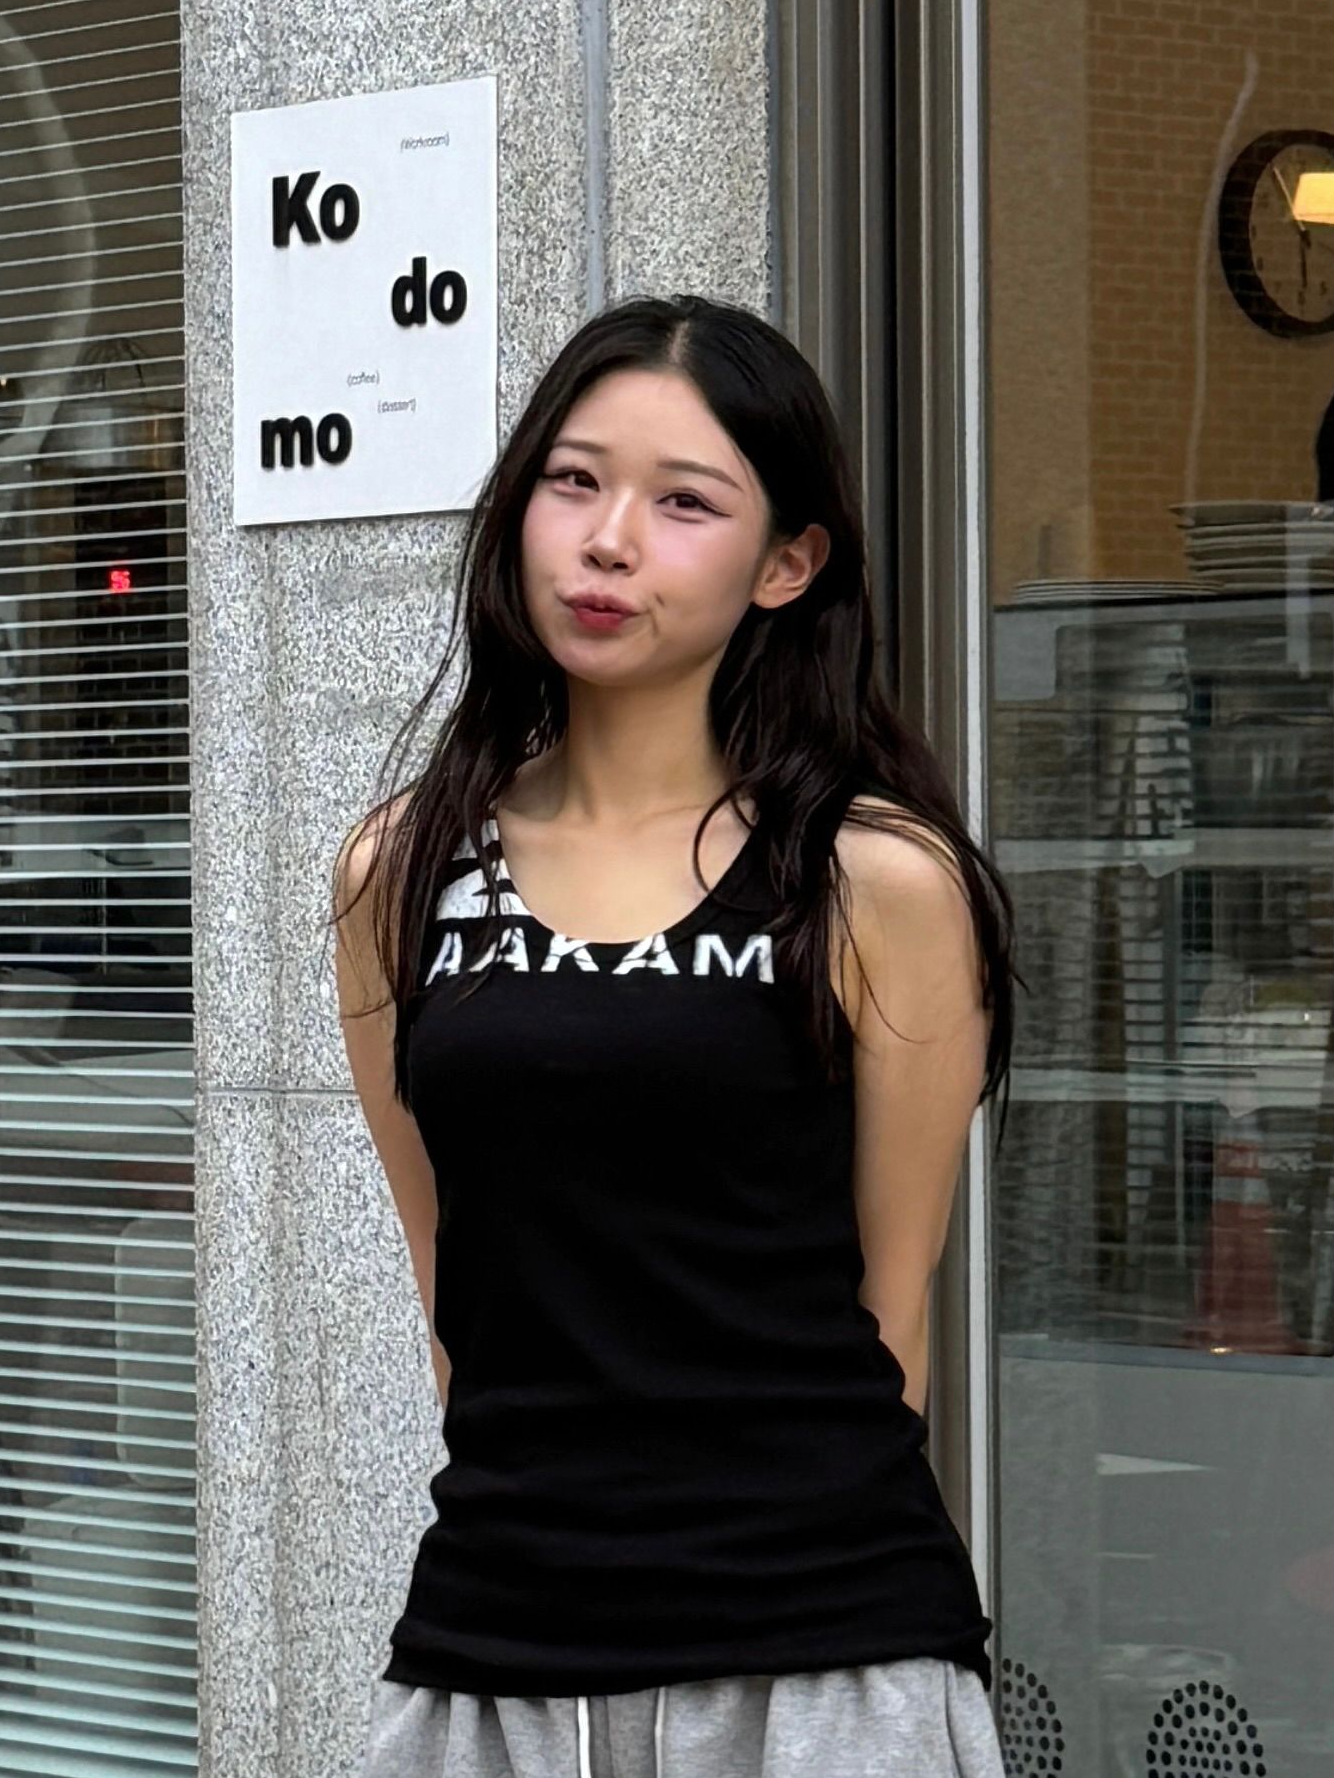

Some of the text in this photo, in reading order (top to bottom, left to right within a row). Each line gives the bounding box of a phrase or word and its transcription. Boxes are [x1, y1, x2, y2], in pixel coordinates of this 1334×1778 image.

[272, 171, 360, 247] Ko
[391, 256, 467, 327] do
[260, 412, 353, 469] mo
